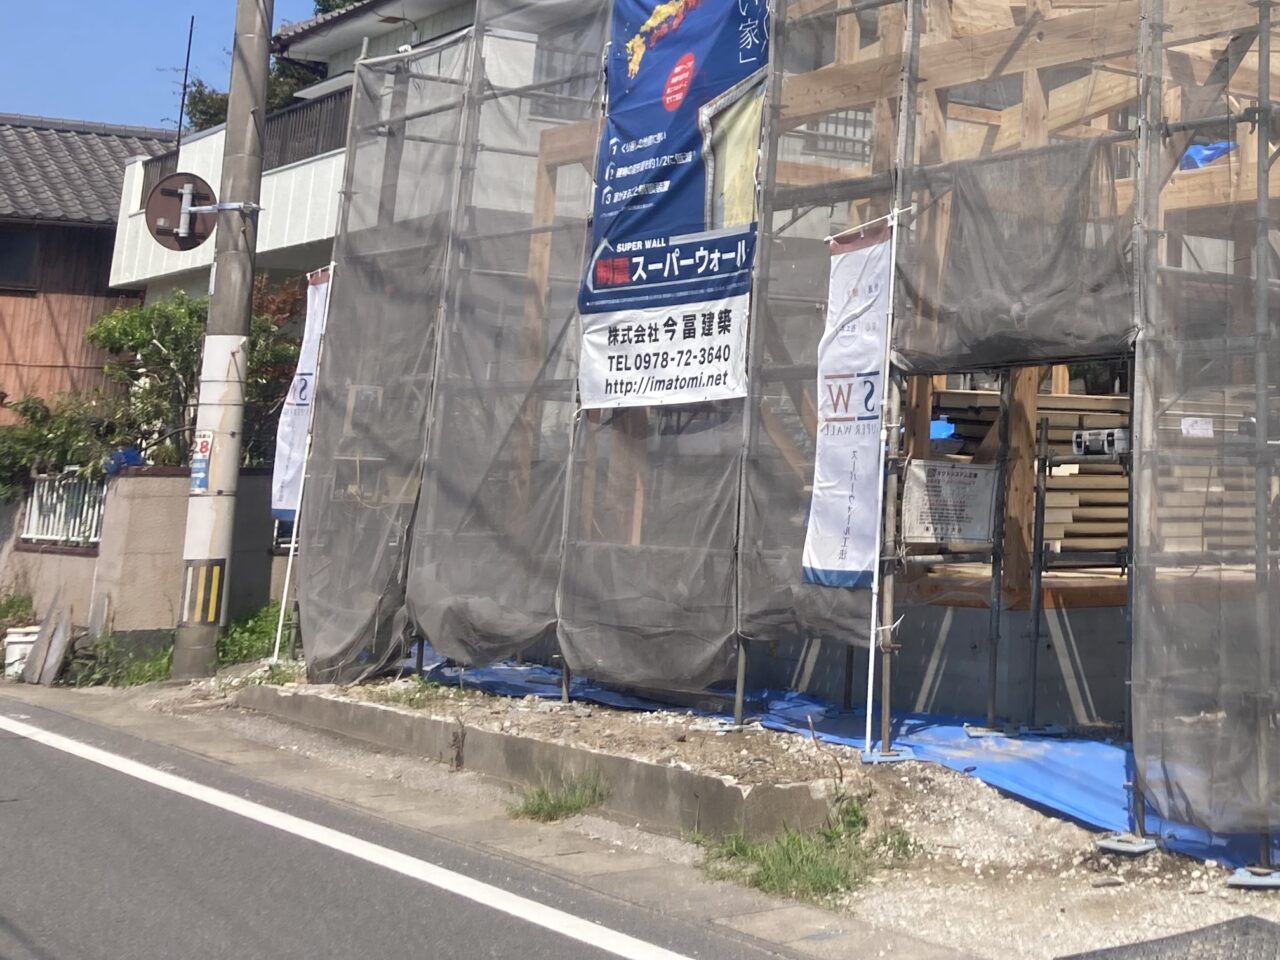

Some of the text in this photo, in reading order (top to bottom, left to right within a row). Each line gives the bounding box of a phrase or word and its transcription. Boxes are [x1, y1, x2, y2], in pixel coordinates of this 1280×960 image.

[616, 237, 667, 253] SUPER WALL
[604, 370, 729, 396] http://imatomi.net
